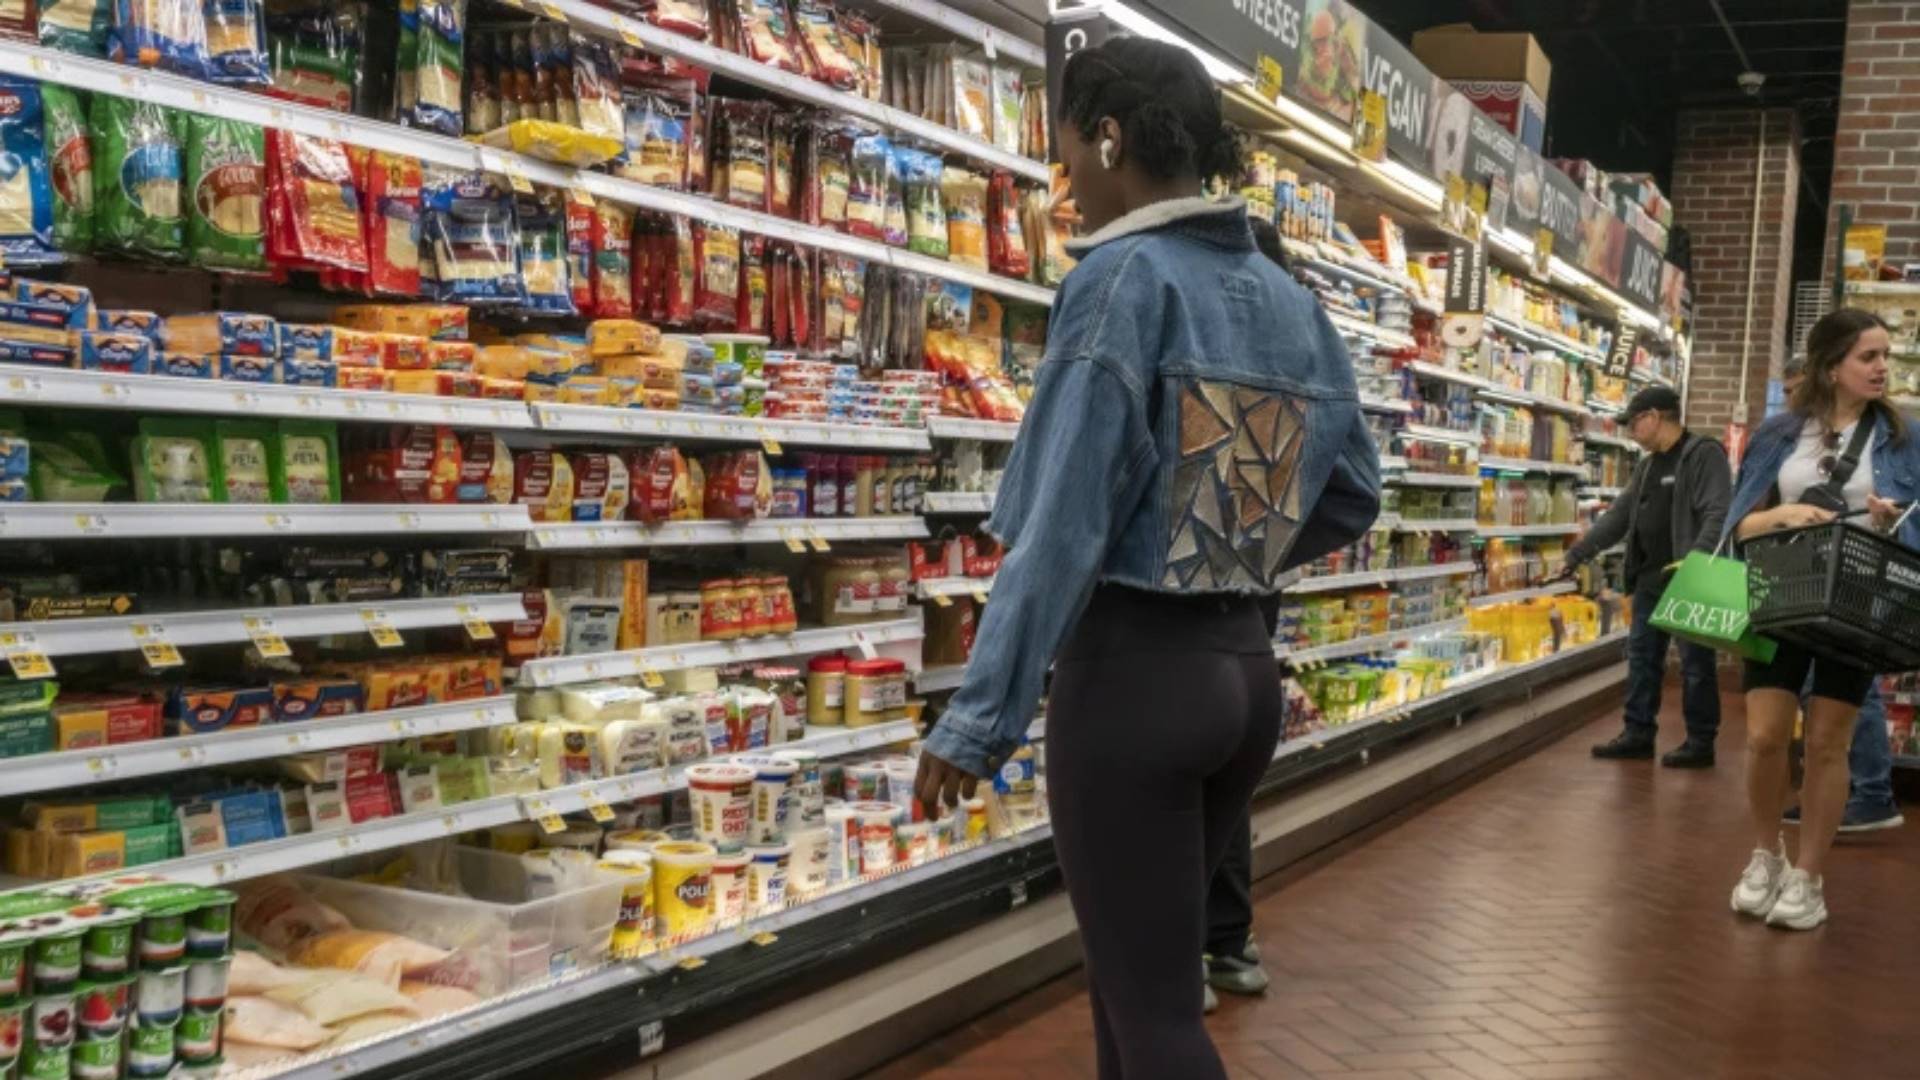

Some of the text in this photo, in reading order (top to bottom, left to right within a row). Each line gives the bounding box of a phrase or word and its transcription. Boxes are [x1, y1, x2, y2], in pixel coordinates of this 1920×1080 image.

[1364, 47, 1426, 147] VEGAN
[1610, 325, 1637, 376] JUICE
[1653, 597, 1749, 634] J.CREW
